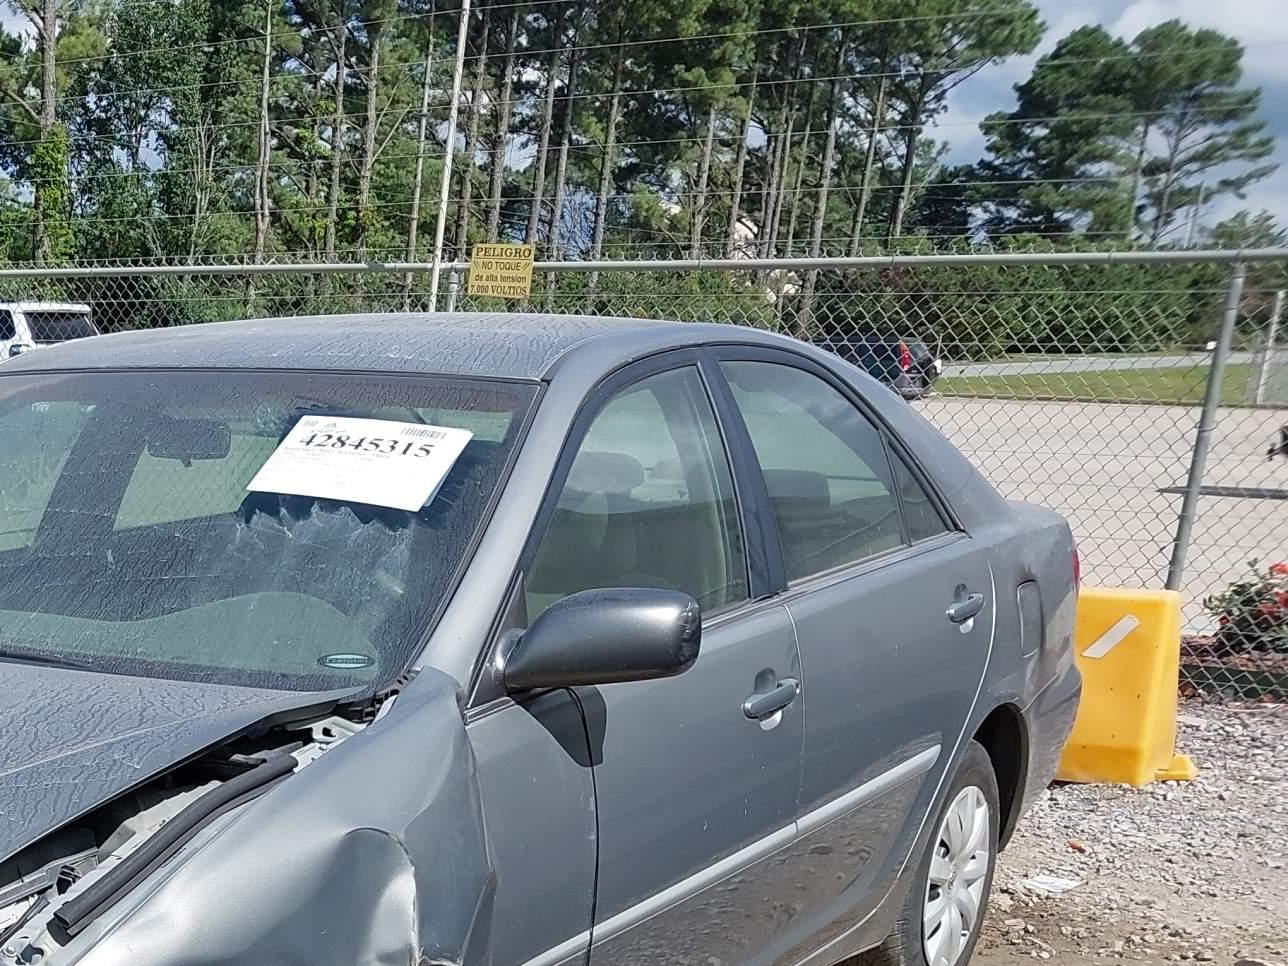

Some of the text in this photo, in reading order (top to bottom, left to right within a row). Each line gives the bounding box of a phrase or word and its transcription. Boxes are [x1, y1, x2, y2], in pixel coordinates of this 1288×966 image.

[476, 247, 532, 258] PELIGRO
[481, 261, 521, 271] NO TOQUE
[474, 273, 484, 282] de
[485, 273, 498, 282] alta
[491, 285, 527, 296] VOLTIOS
[299, 433, 435, 458] 42845315
